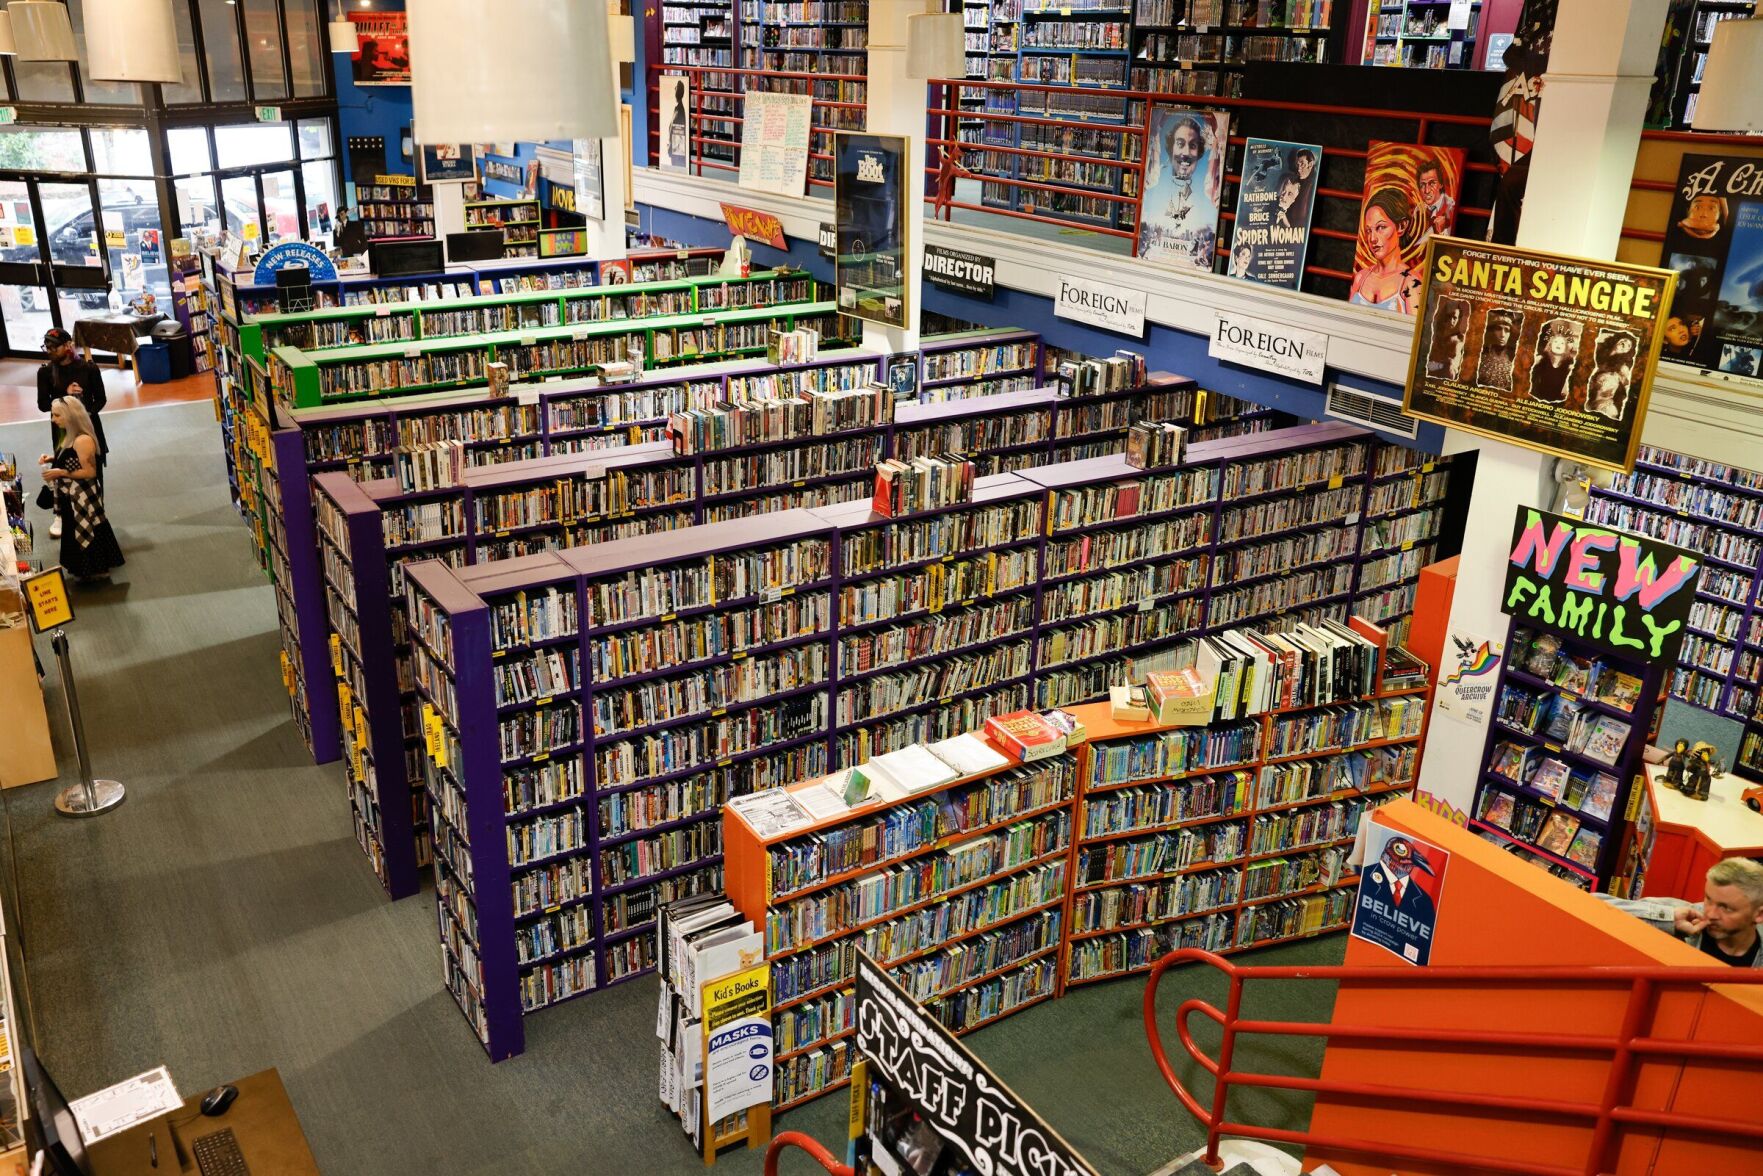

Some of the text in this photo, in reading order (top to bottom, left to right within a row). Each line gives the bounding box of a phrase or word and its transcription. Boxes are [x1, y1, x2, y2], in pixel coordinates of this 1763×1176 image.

[261, 107, 276, 121] EXIT
[1682, 160, 1726, 201] A
[1243, 191, 1277, 203] RATHBONE
[1249, 212, 1270, 223] BRUCE
[1236, 225, 1305, 247] SPIDER WOMAN
[265, 248, 325, 270] NEW RELEASES
[936, 247, 950, 256] FILMS
[949, 250, 975, 261] ORGANIZED
[1462, 249, 1492, 260] FORGET
[1492, 253, 1540, 268] EVERYTHING
[1541, 261, 1559, 271] YOU
[1559, 264, 1583, 275] HAVE
[1583, 268, 1606, 279] EVER
[924, 252, 994, 285] DIRECTOR
[1435, 254, 1522, 296] SANTA
[1060, 281, 1129, 316] FOREIGN
[1462, 288, 1483, 297] MODERN
[1526, 299, 1559, 310] BRILLIANTLY
[1512, 302, 1524, 310] THE
[1559, 311, 1576, 320] SHOW
[1217, 318, 1324, 360] FOREIGN FILMS
[1258, 351, 1277, 365] Country
[1443, 380, 1499, 398] CLAUDIO ARGENTO
[1515, 397, 1600, 422] ALEJANDRO JODOROWSKY
[1554, 412, 1584, 426] ALEJANDRO
[1583, 419, 1619, 434] JODOROWSKY
[1509, 509, 1700, 612] NEW
[38, 596, 59, 608] STARTS
[39, 588, 52, 598] LINE
[43, 606, 57, 615] HERE
[1507, 575, 1681, 658] FAMILY
[1454, 685, 1492, 696] QUEERCROW
[1460, 692, 1488, 701] ARCHIVE
[1361, 895, 1431, 940] BELIEVE
[1370, 912, 1378, 920] in
[1396, 926, 1418, 941] power
[714, 977, 759, 1002] Kid's Books
[711, 1024, 759, 1050] MASKS
[859, 998, 967, 1126] STAFF
